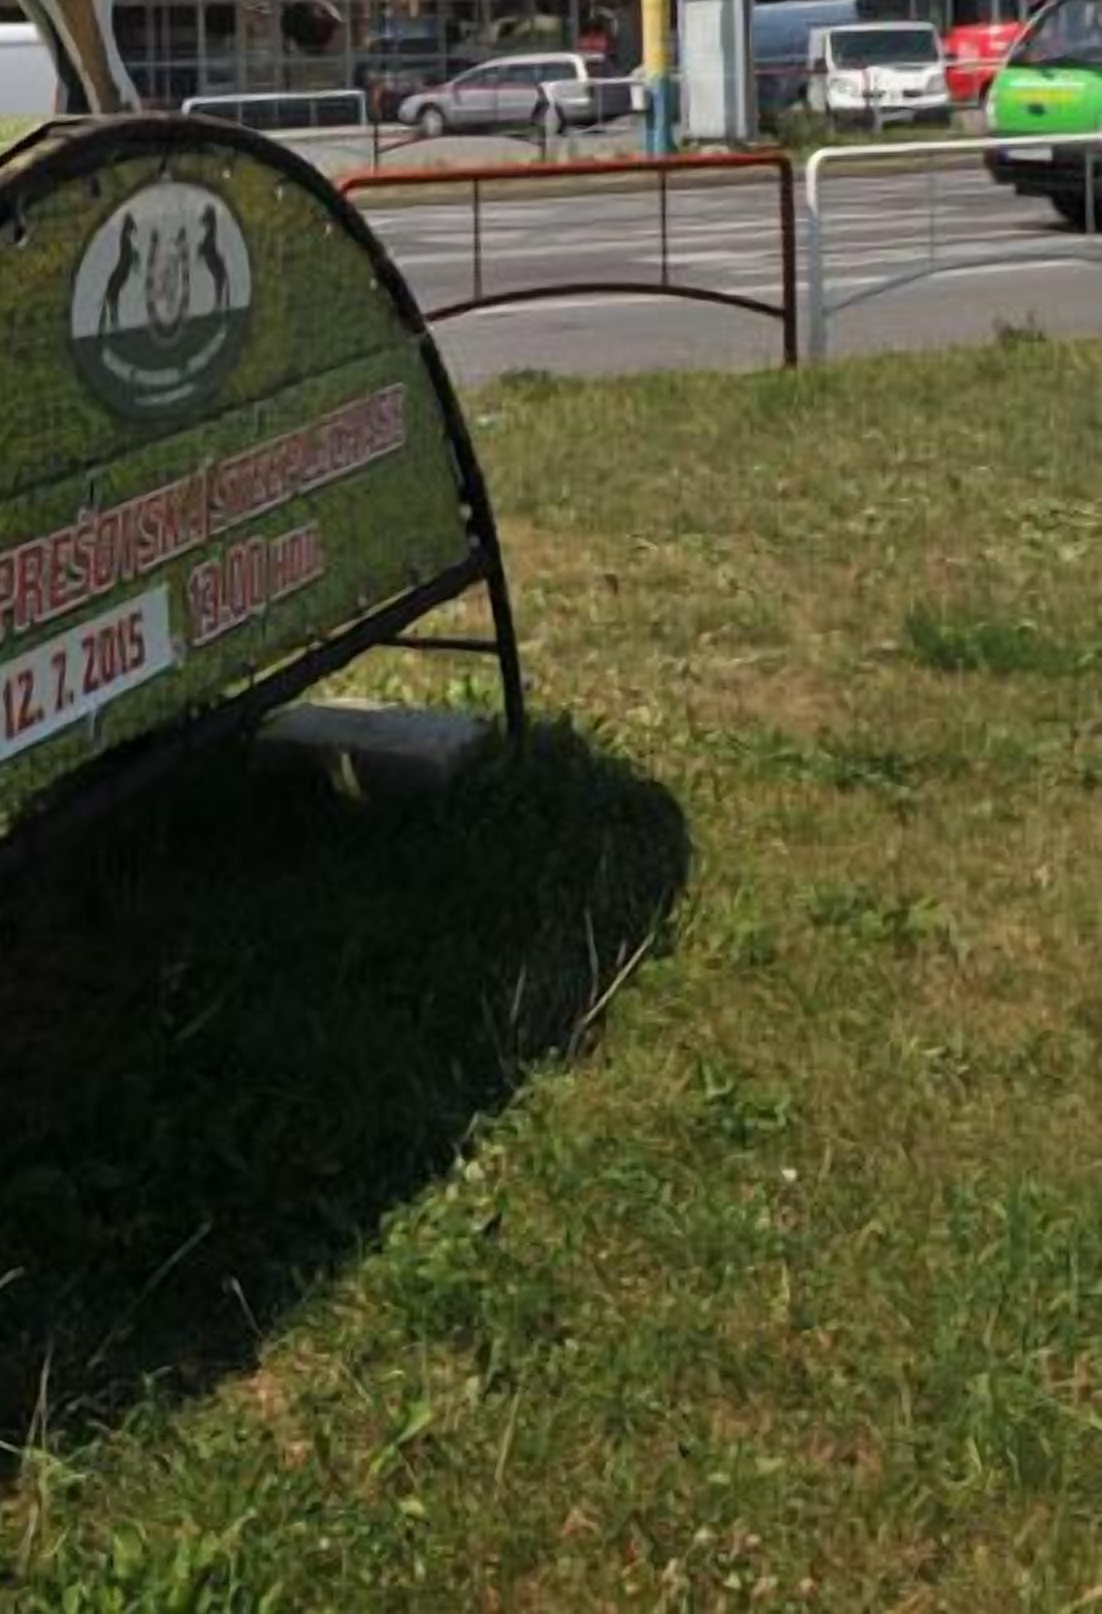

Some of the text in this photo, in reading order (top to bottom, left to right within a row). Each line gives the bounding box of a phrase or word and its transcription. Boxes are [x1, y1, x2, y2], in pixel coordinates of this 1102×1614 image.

[2, 671, 44, 739] 12.
[51, 651, 74, 713] 7.
[81, 612, 145, 695] 2015
